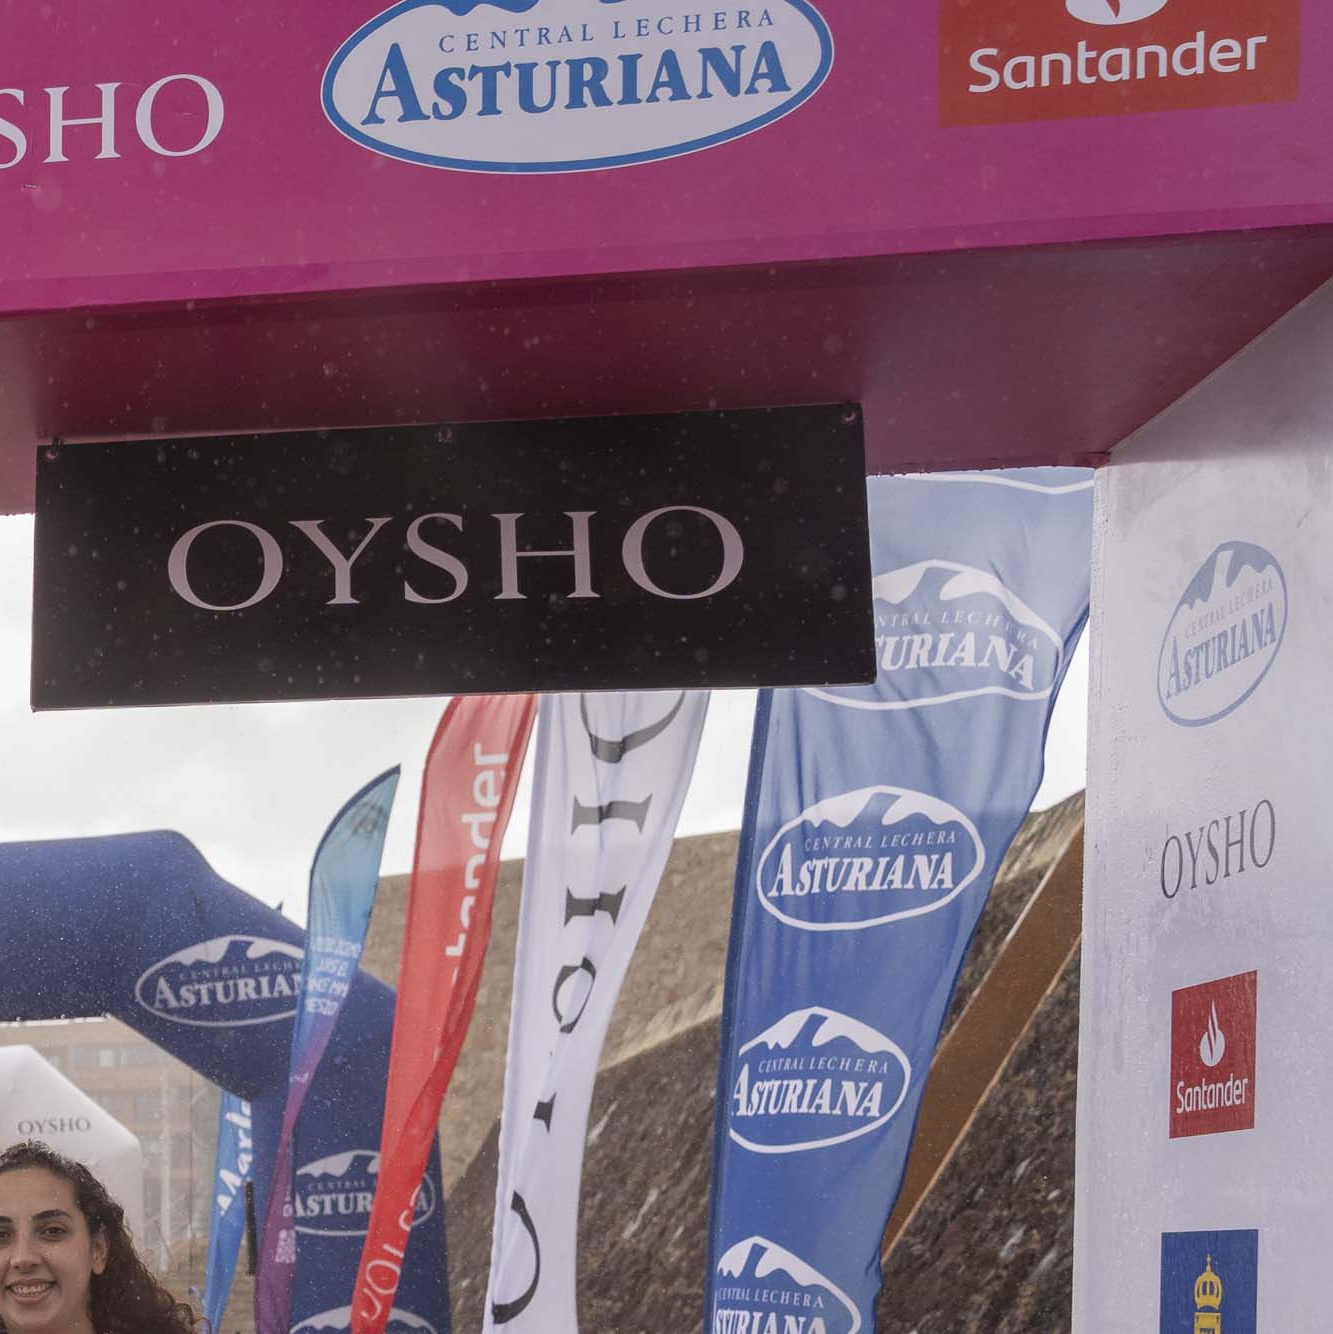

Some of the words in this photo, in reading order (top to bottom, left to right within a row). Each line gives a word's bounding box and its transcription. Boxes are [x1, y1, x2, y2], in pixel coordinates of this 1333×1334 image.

[440, 23, 594, 53] CENTRAL
[613, 8, 774, 39] LECHERA
[361, 40, 792, 126] ASTURIANA
[968, 31, 1267, 94] Santander
[166, 505, 744, 612] OYSHO
[876, 613, 931, 626] NTRAL
[876, 632, 1035, 690] URIANA
[1166, 601, 1277, 700] ASTURIANA
[805, 835, 874, 850] CENTRAL
[881, 831, 956, 849] LECHERA
[1160, 799, 1276, 900] OYSHO
[768, 843, 954, 898] ASTURIANA
[732, 1063, 883, 1117] ASTURIANA
[758, 1057, 804, 1073] CENTRAL
[809, 1056, 888, 1073] LECHERA
[1177, 1076, 1249, 1115] Santander
[18, 1116, 91, 1136] OYSHO
[754, 1289, 823, 1309] LECHERA
